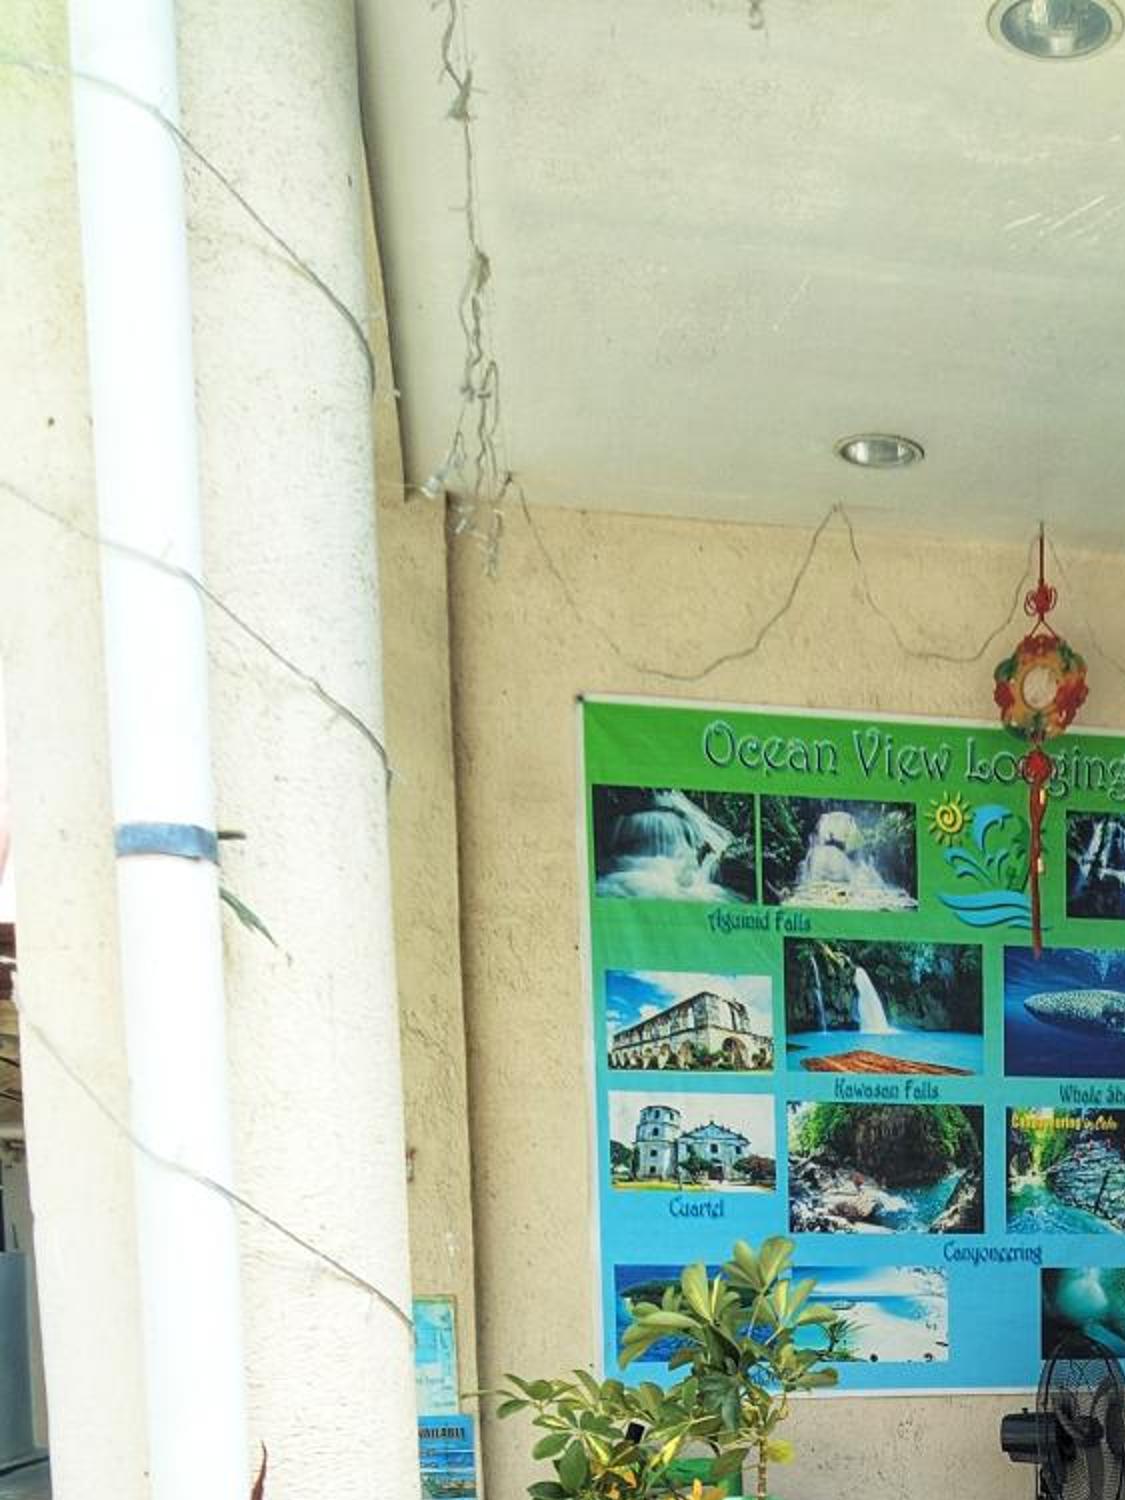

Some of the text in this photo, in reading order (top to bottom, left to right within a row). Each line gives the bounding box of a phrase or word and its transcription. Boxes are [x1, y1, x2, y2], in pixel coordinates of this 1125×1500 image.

[703, 719, 837, 778] Ocean
[853, 727, 951, 781] View
[775, 910, 811, 932] Falls
[834, 1077, 940, 1100] Kawasan Falls
[1059, 1084, 1101, 1104] Whale
[669, 1194, 724, 1219] Cuartel
[943, 1240, 1042, 1266] Canyoneering
